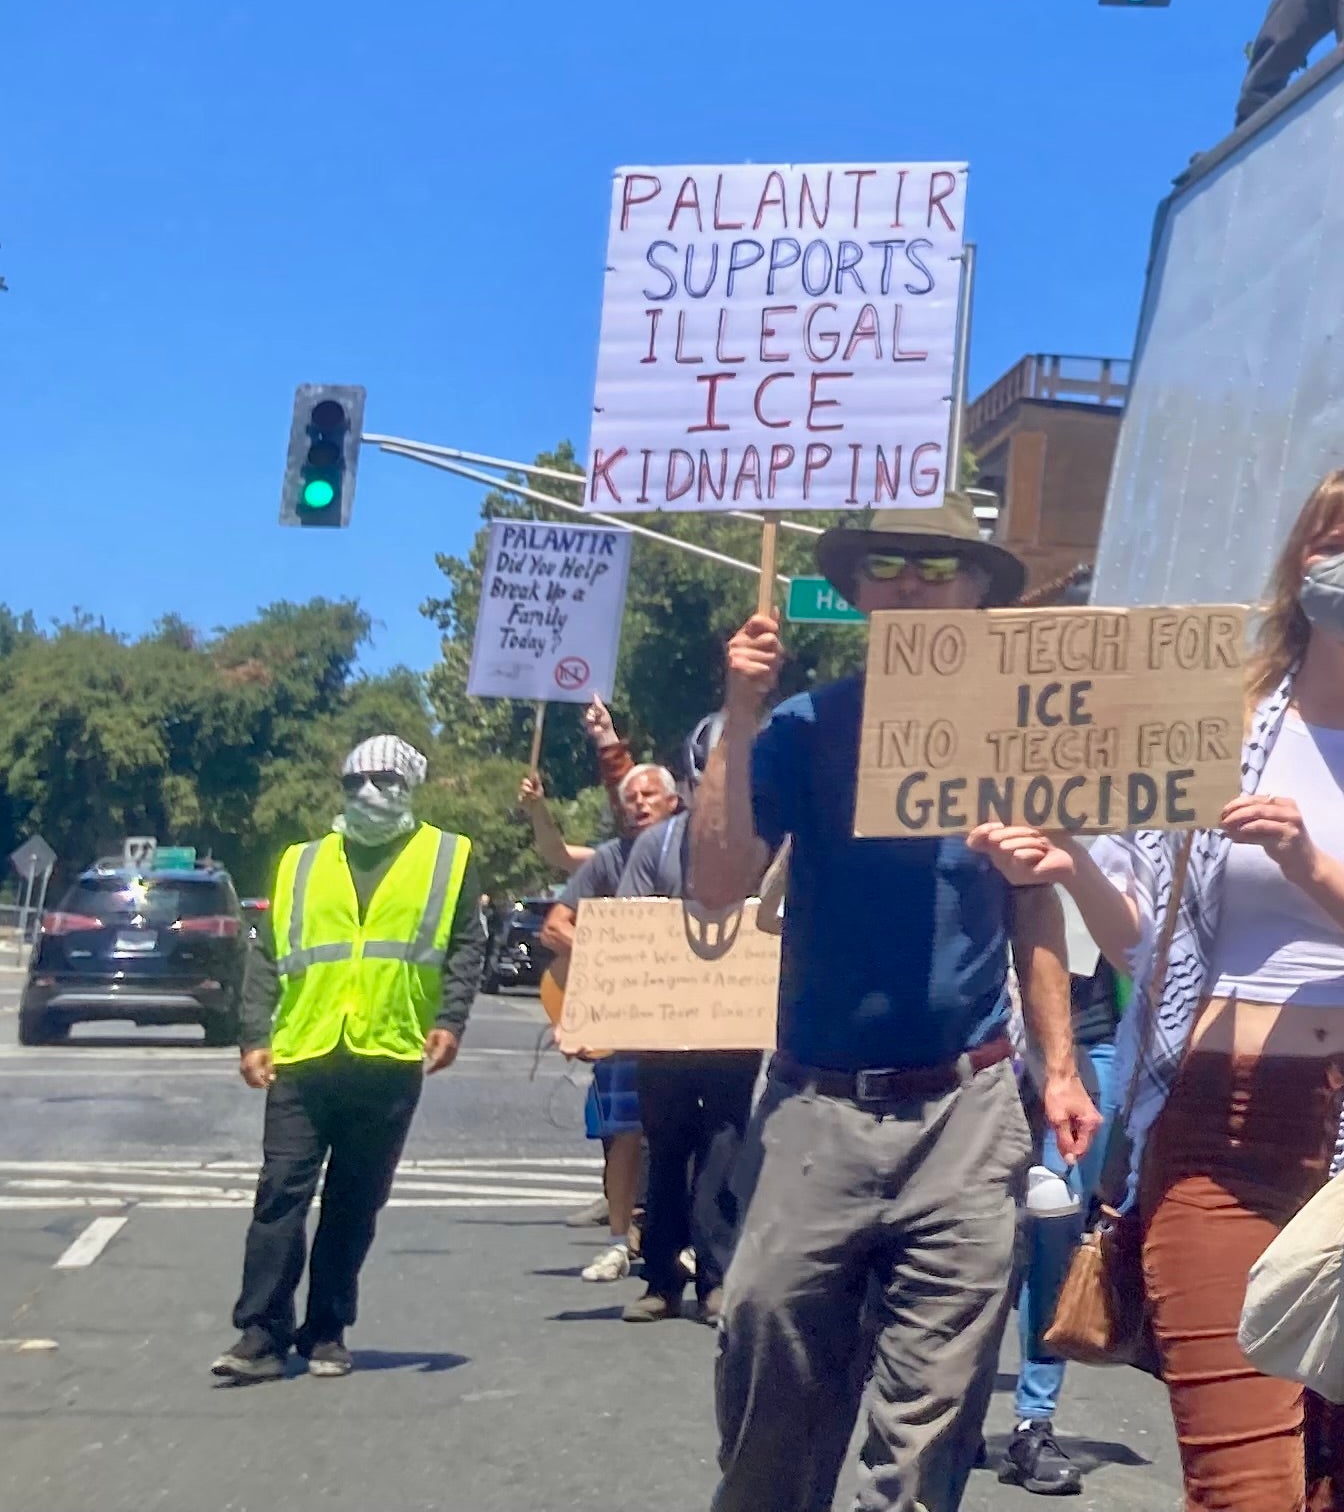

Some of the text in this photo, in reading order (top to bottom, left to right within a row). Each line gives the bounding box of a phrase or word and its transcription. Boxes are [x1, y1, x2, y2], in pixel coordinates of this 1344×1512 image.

[620, 169, 958, 233] PALANTIR
[642, 236, 936, 302] SUPPORTS
[639, 302, 929, 365] ILLEGAL
[686, 370, 856, 434] ICE
[589, 441, 943, 506] KIDNAPPING
[495, 551, 610, 587] Did You Help
[501, 525, 618, 556] PALANTIR
[489, 577, 540, 602] Break
[507, 602, 569, 635] Family
[884, 613, 1242, 676] NO TECH FOR
[1016, 680, 1094, 728] ICE
[876, 717, 1233, 774] NO TECH FOR
[895, 768, 1197, 831] GENOCIDE
